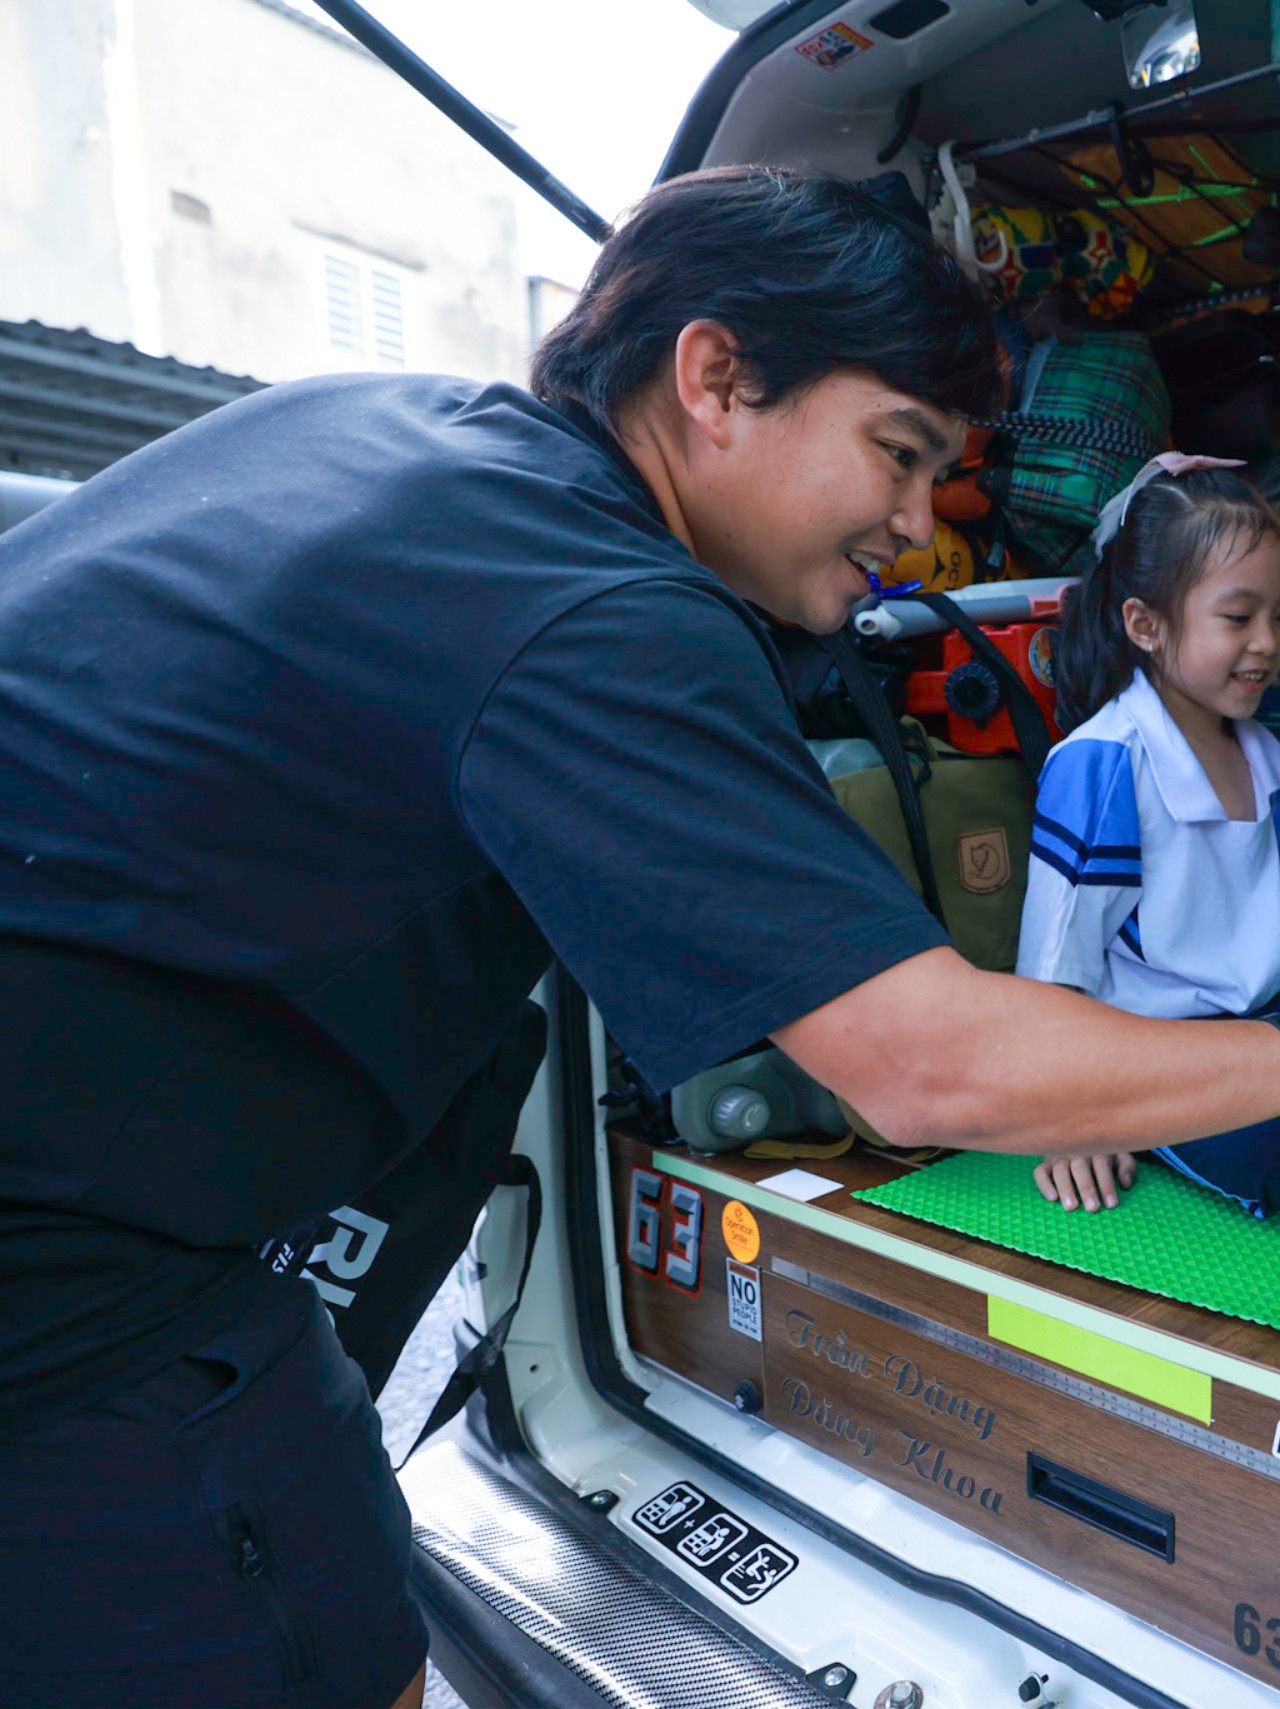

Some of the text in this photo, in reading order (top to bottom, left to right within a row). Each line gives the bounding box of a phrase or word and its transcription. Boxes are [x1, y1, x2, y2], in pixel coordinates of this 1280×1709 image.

[626, 1164, 705, 1298] 63
[730, 1273, 757, 1305] NO
[884, 1354, 998, 1441] Đặng
[889, 1427, 1008, 1518] Khoa
